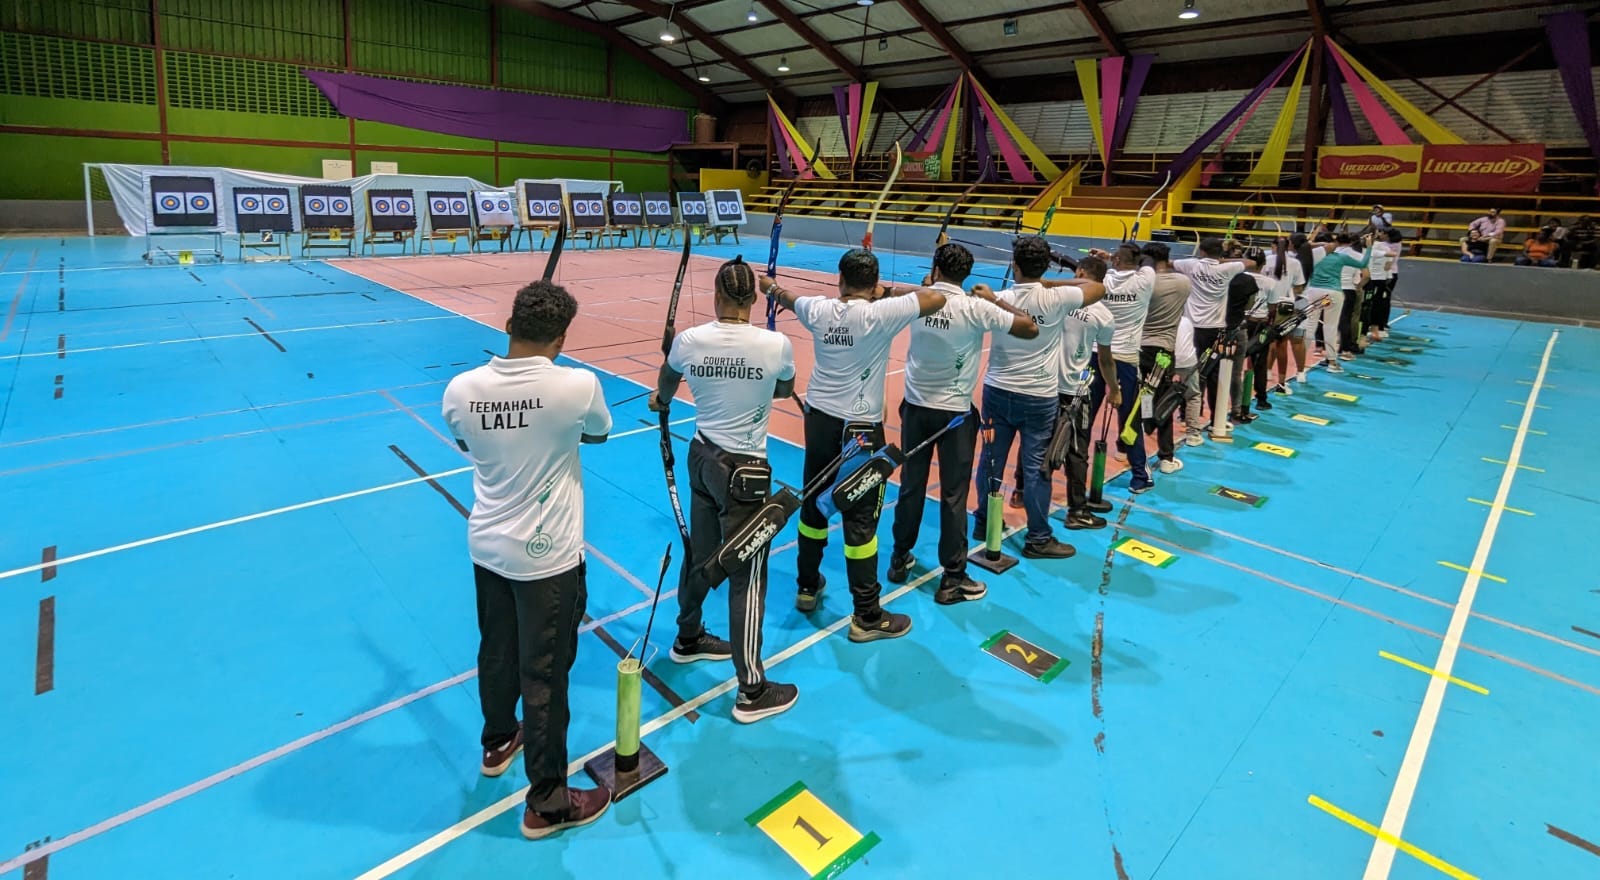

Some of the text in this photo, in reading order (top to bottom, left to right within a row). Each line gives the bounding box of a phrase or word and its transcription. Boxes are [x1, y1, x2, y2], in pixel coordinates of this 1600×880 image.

[1340, 162, 1390, 172] Lucozade
[1423, 158, 1519, 174] Lucozade
[924, 316, 950, 330] RAM
[823, 333, 854, 347] SUKHU
[703, 356, 747, 367] COURTLEE
[690, 364, 764, 381] RODRIGUES
[469, 398, 544, 413] TEEMAHALL
[481, 412, 529, 431] LALL
[1131, 546, 1157, 559] 3
[1005, 643, 1039, 664] 2
[792, 815, 834, 850] 1
